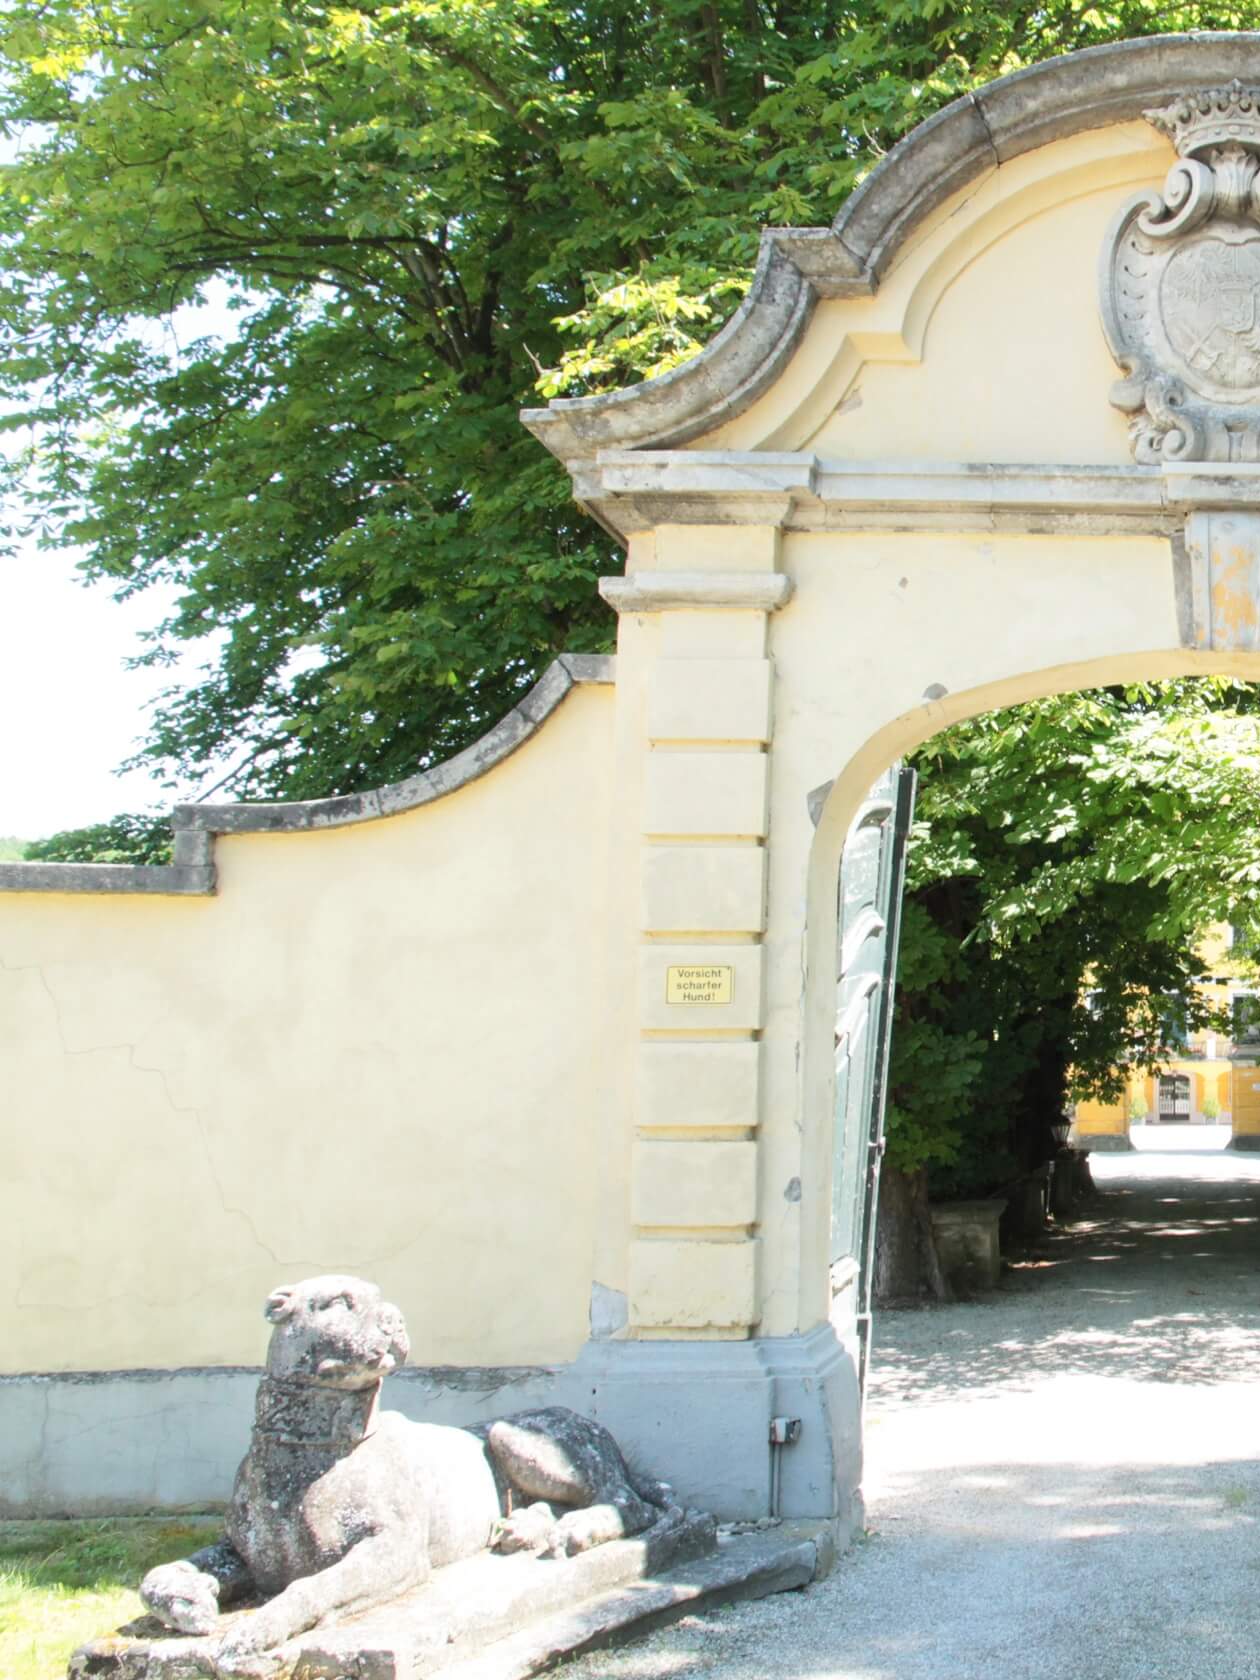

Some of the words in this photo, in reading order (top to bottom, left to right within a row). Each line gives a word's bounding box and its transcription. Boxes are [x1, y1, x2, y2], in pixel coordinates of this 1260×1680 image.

[677, 969, 722, 978] Vorsicht
[676, 981, 722, 990] scharfer
[682, 992, 716, 1001] Hund!
